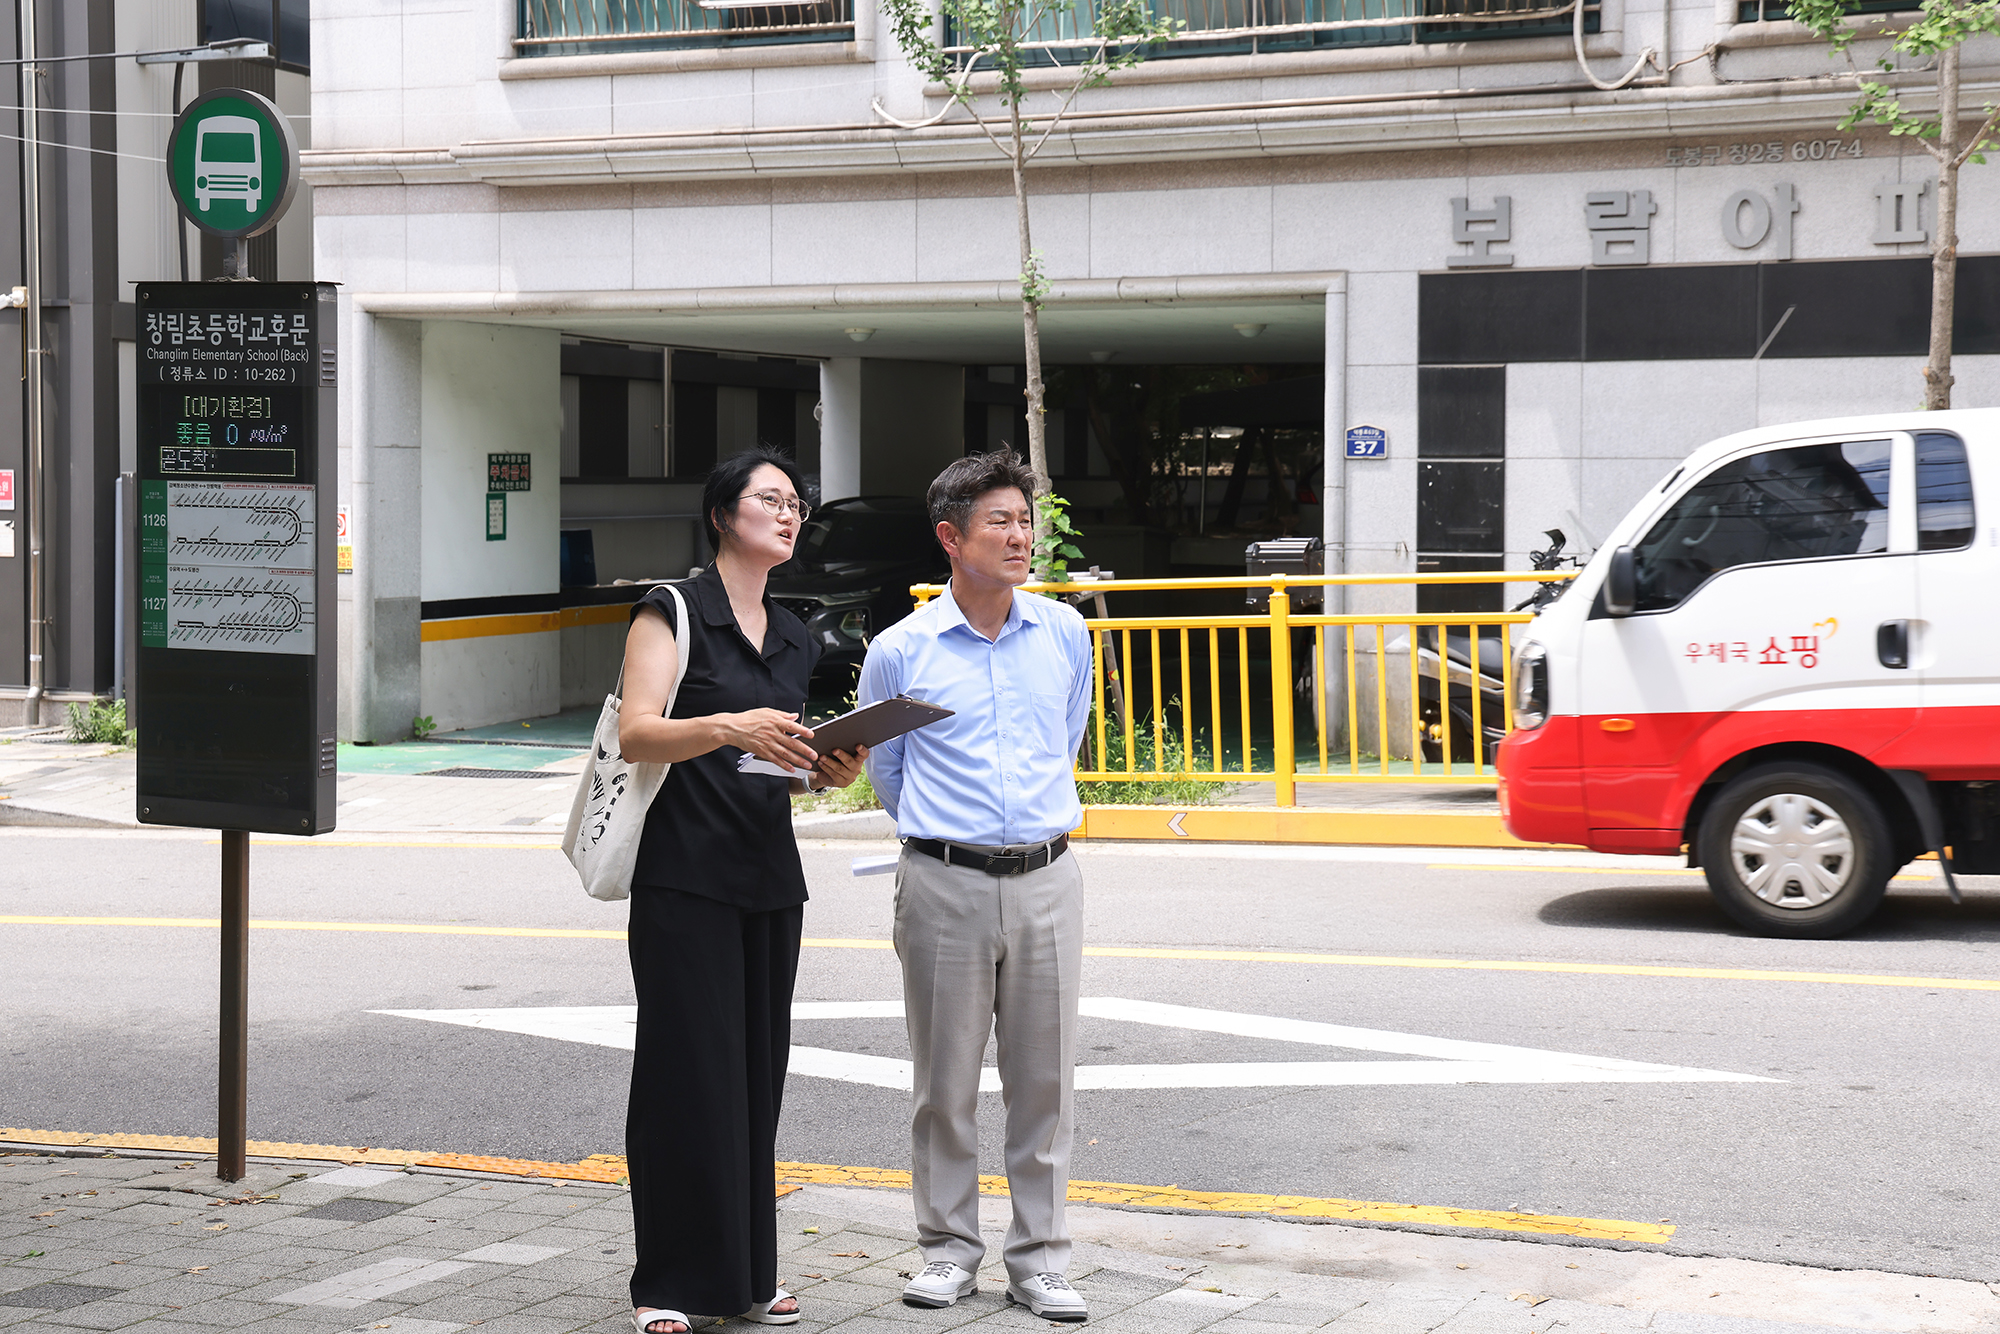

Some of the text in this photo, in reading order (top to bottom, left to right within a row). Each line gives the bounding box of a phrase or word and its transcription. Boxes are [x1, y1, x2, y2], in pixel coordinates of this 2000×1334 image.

[1664, 138, 1864, 168] 도봉구 창2동 607-4
[146, 312, 310, 346] 창림초등학교후문
[146, 347, 309, 363] Changlim Elementary School (Back)
[170, 366, 207, 382] 정류소
[213, 368, 228, 380] ID
[244, 367, 286, 381] 10-262
[184, 395, 271, 419] [대기환경]
[176, 422, 212, 445] 좋음
[226, 423, 239, 445] 0
[1353, 440, 1378, 455] 37
[162, 449, 216, 471] 곧도착:
[490, 464, 529, 481] 주차금지
[143, 513, 167, 527] 1126
[143, 597, 167, 611] 1127
[1684, 635, 1819, 669] 우체국 쇼핑
